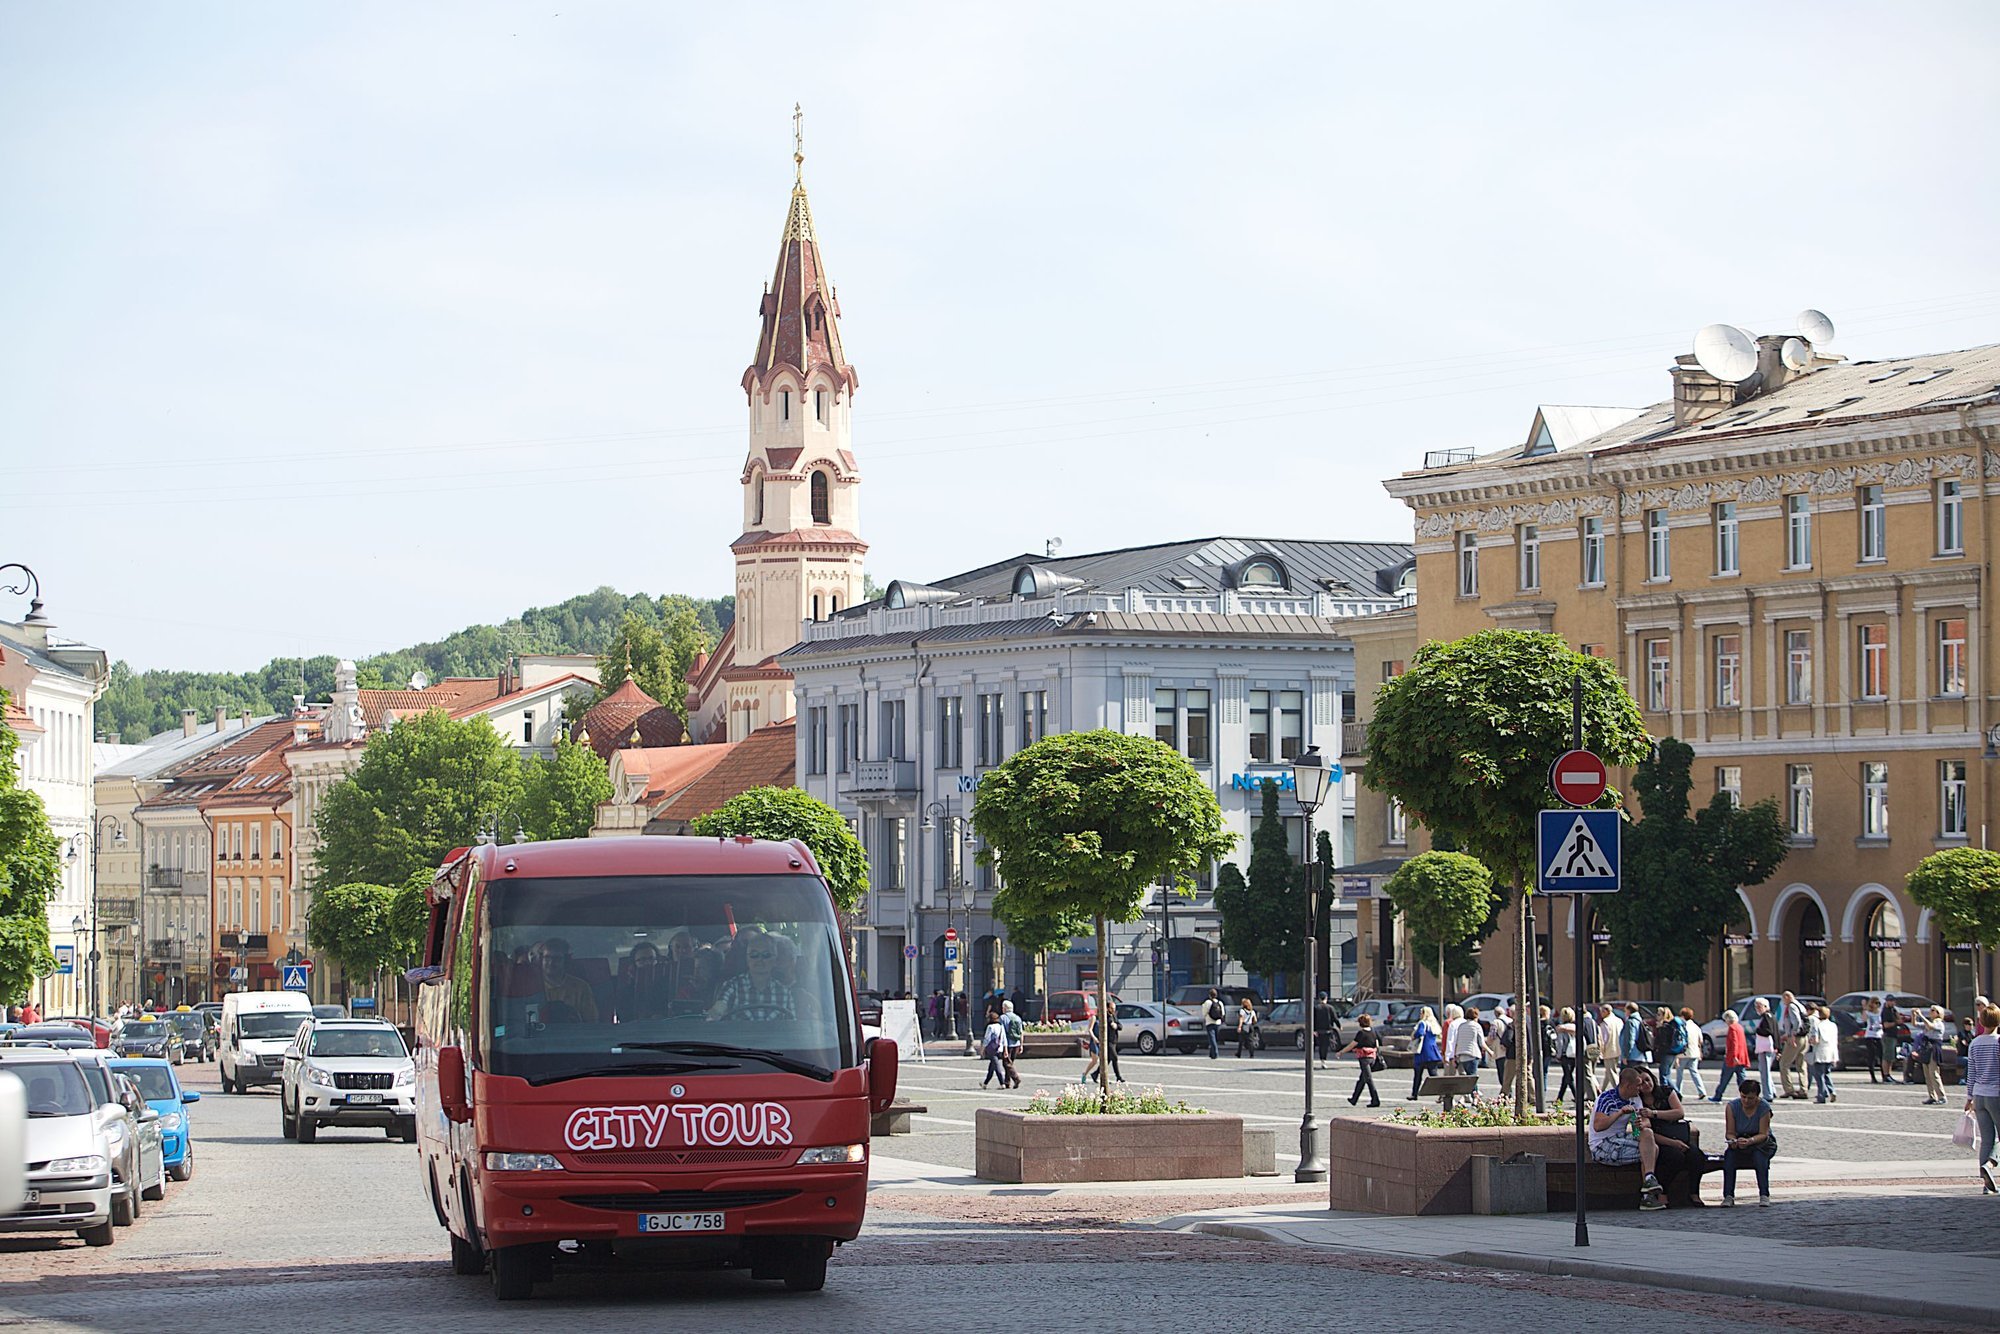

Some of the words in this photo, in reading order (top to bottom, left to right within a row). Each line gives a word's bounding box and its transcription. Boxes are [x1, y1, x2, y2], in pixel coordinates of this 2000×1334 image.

[957, 774, 982, 792] Nord
[1232, 771, 1296, 791] Node
[948, 948, 956, 959] P
[565, 1105, 669, 1150] CITY
[672, 1102, 793, 1147] TOUR
[23, 1191, 38, 1202] 78
[648, 1215, 683, 1230] GJC
[693, 1214, 722, 1229] 758
